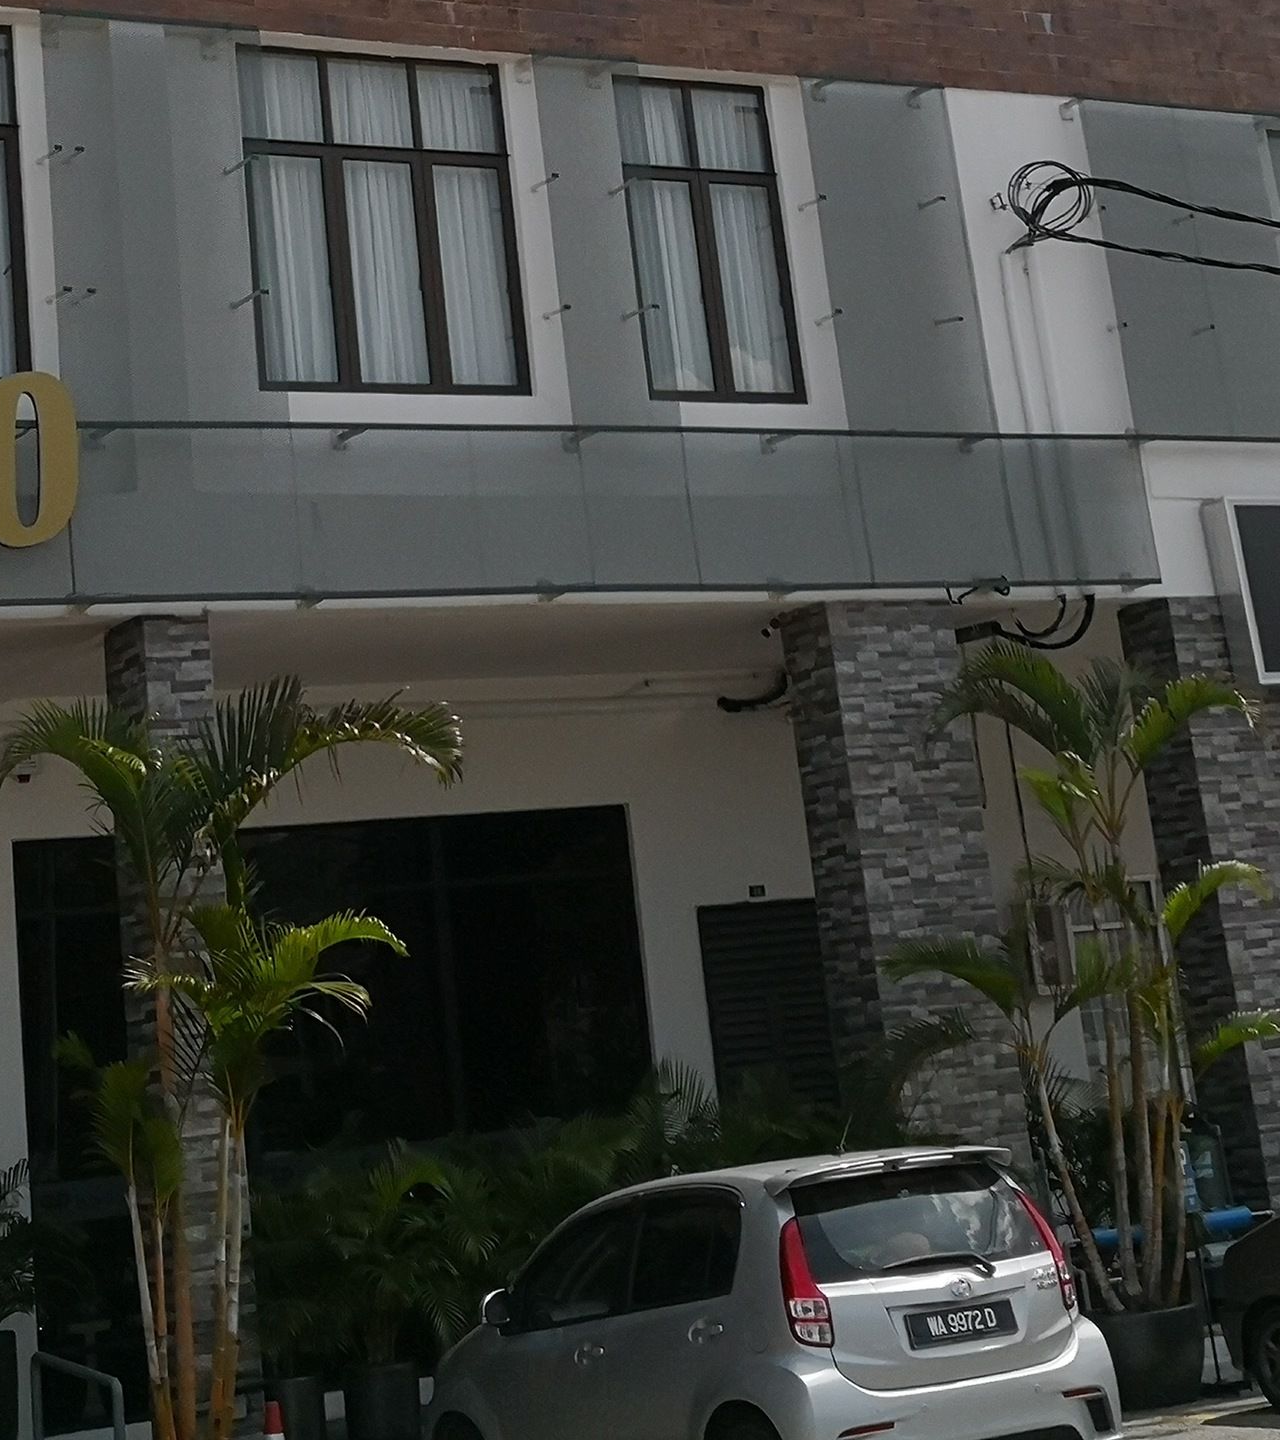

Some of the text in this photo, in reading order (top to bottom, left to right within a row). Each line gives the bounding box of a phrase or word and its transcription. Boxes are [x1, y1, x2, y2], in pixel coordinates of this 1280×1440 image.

[926, 1308, 997, 1336] WA 9972 D
